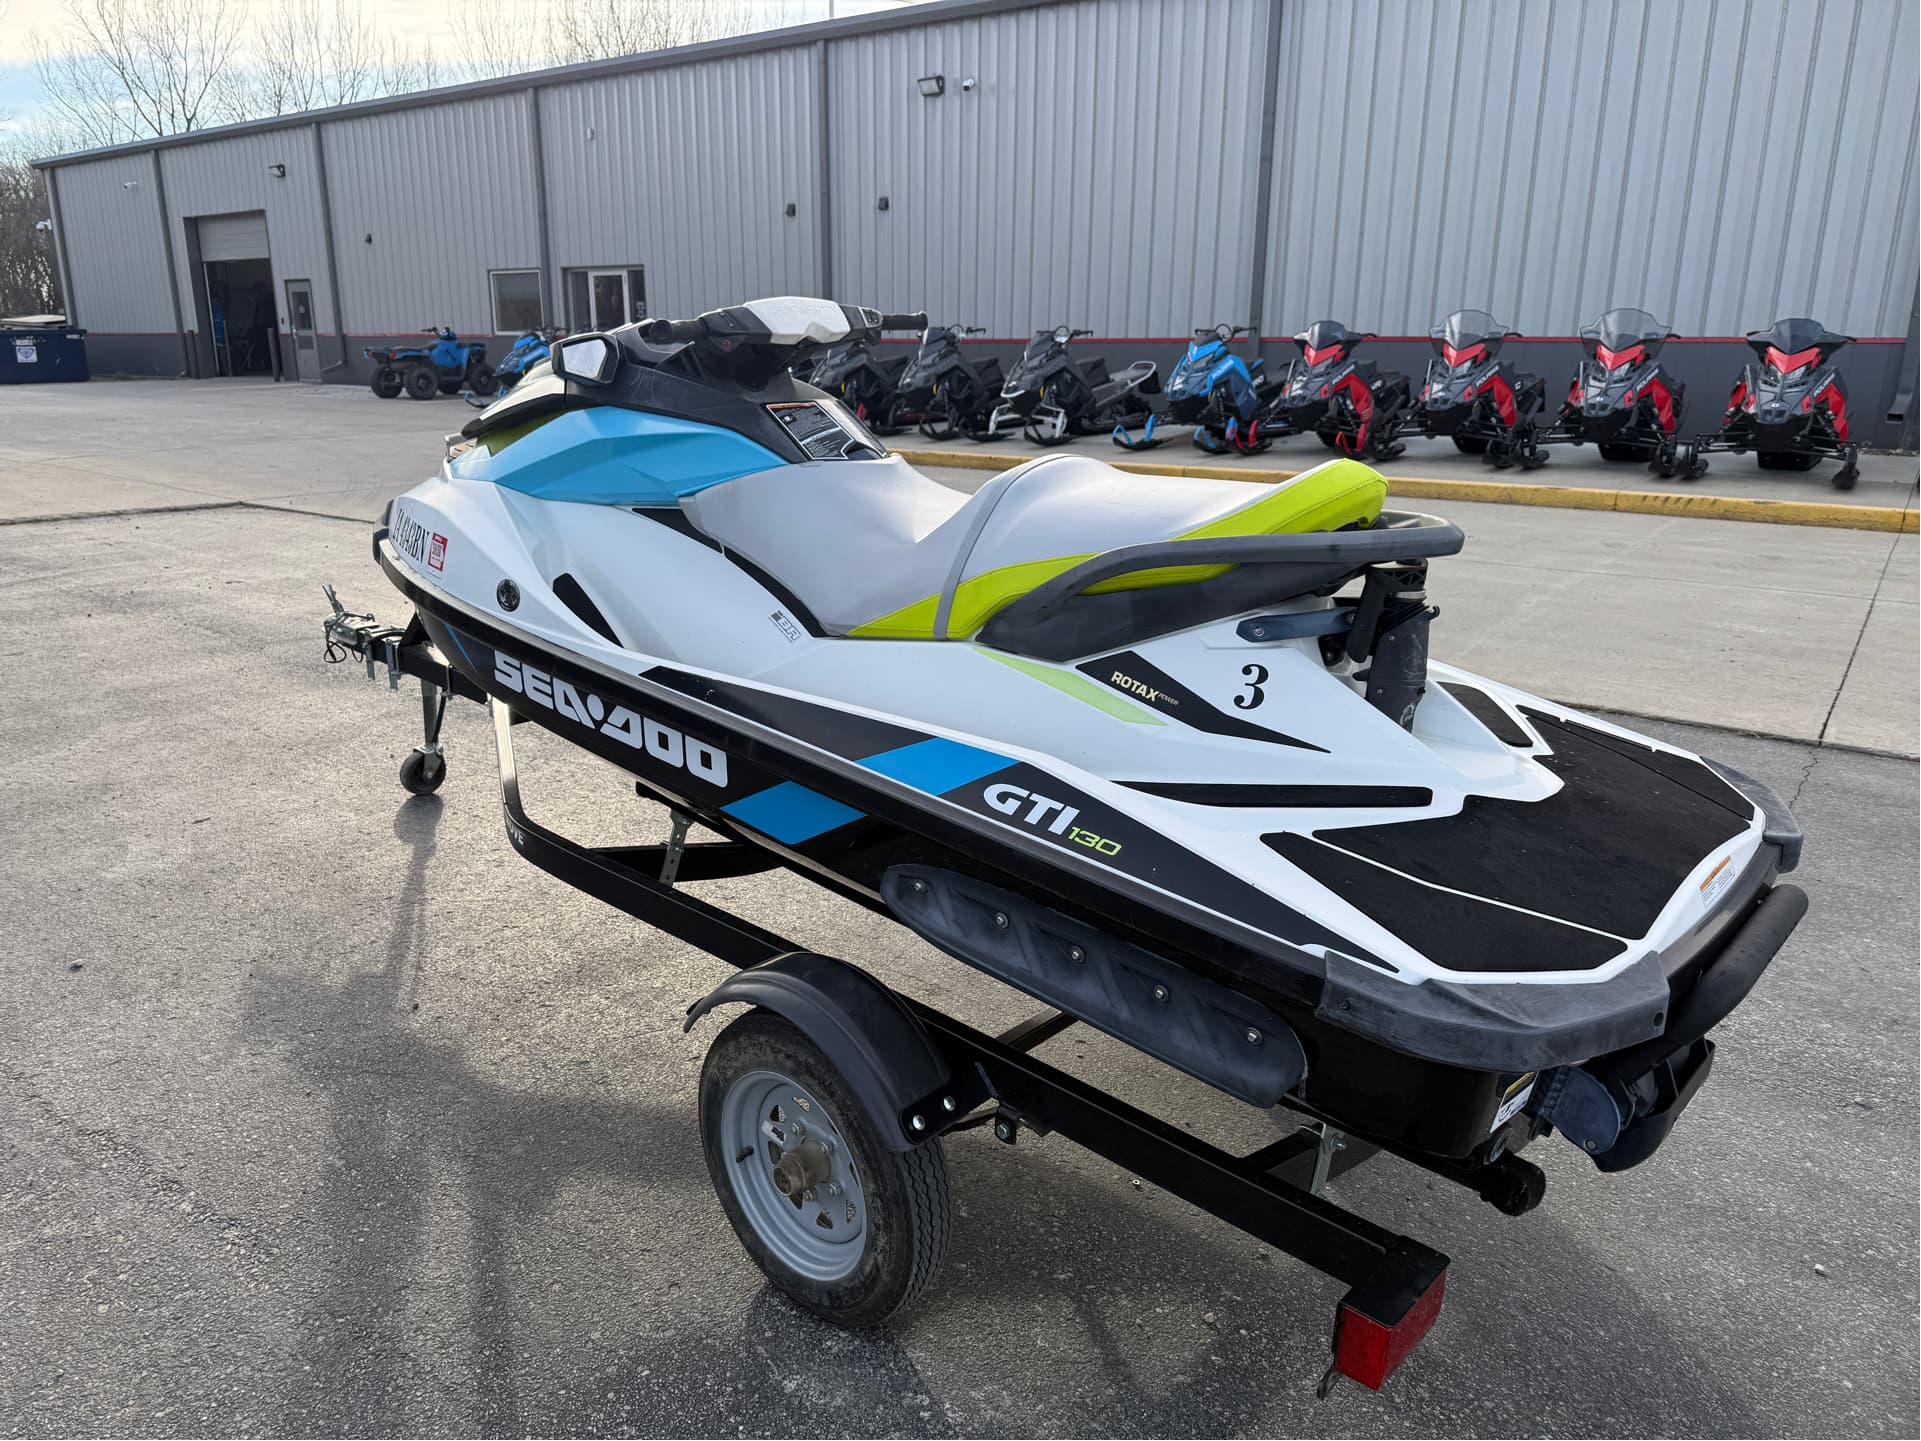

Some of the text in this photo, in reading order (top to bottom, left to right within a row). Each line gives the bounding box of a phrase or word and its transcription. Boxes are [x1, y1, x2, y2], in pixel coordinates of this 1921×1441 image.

[1111, 670, 1180, 707] ROTAX POWER
[1233, 663, 1269, 710] 3
[983, 783, 1122, 857] GTI 130
